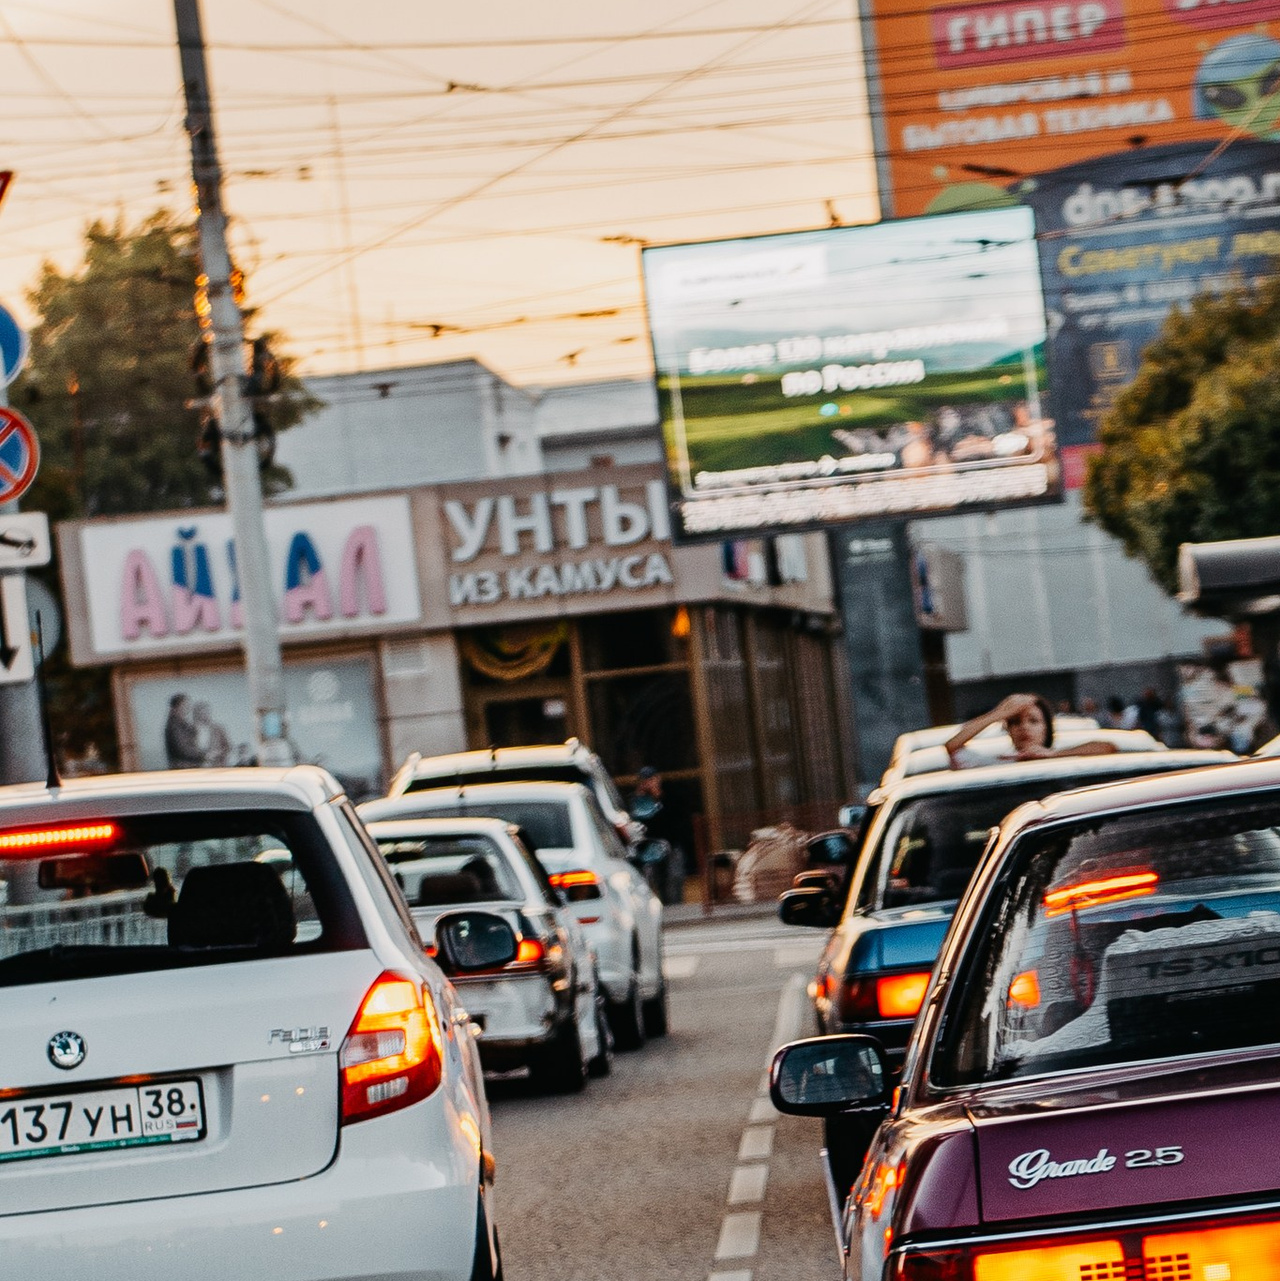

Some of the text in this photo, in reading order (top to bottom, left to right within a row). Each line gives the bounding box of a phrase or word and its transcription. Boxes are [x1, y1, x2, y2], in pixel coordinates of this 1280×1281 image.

[946, 2, 1106, 52] ГИПЕР
[442, 479, 671, 562] УНТЫ
[120, 525, 387, 640] АЙАЛ
[449, 553, 674, 606] ИЗ КАМУСА
[144, 1087, 186, 1119] 38
[144, 1119, 175, 1132] RUS
[1008, 1148, 1118, 1189] Grande
